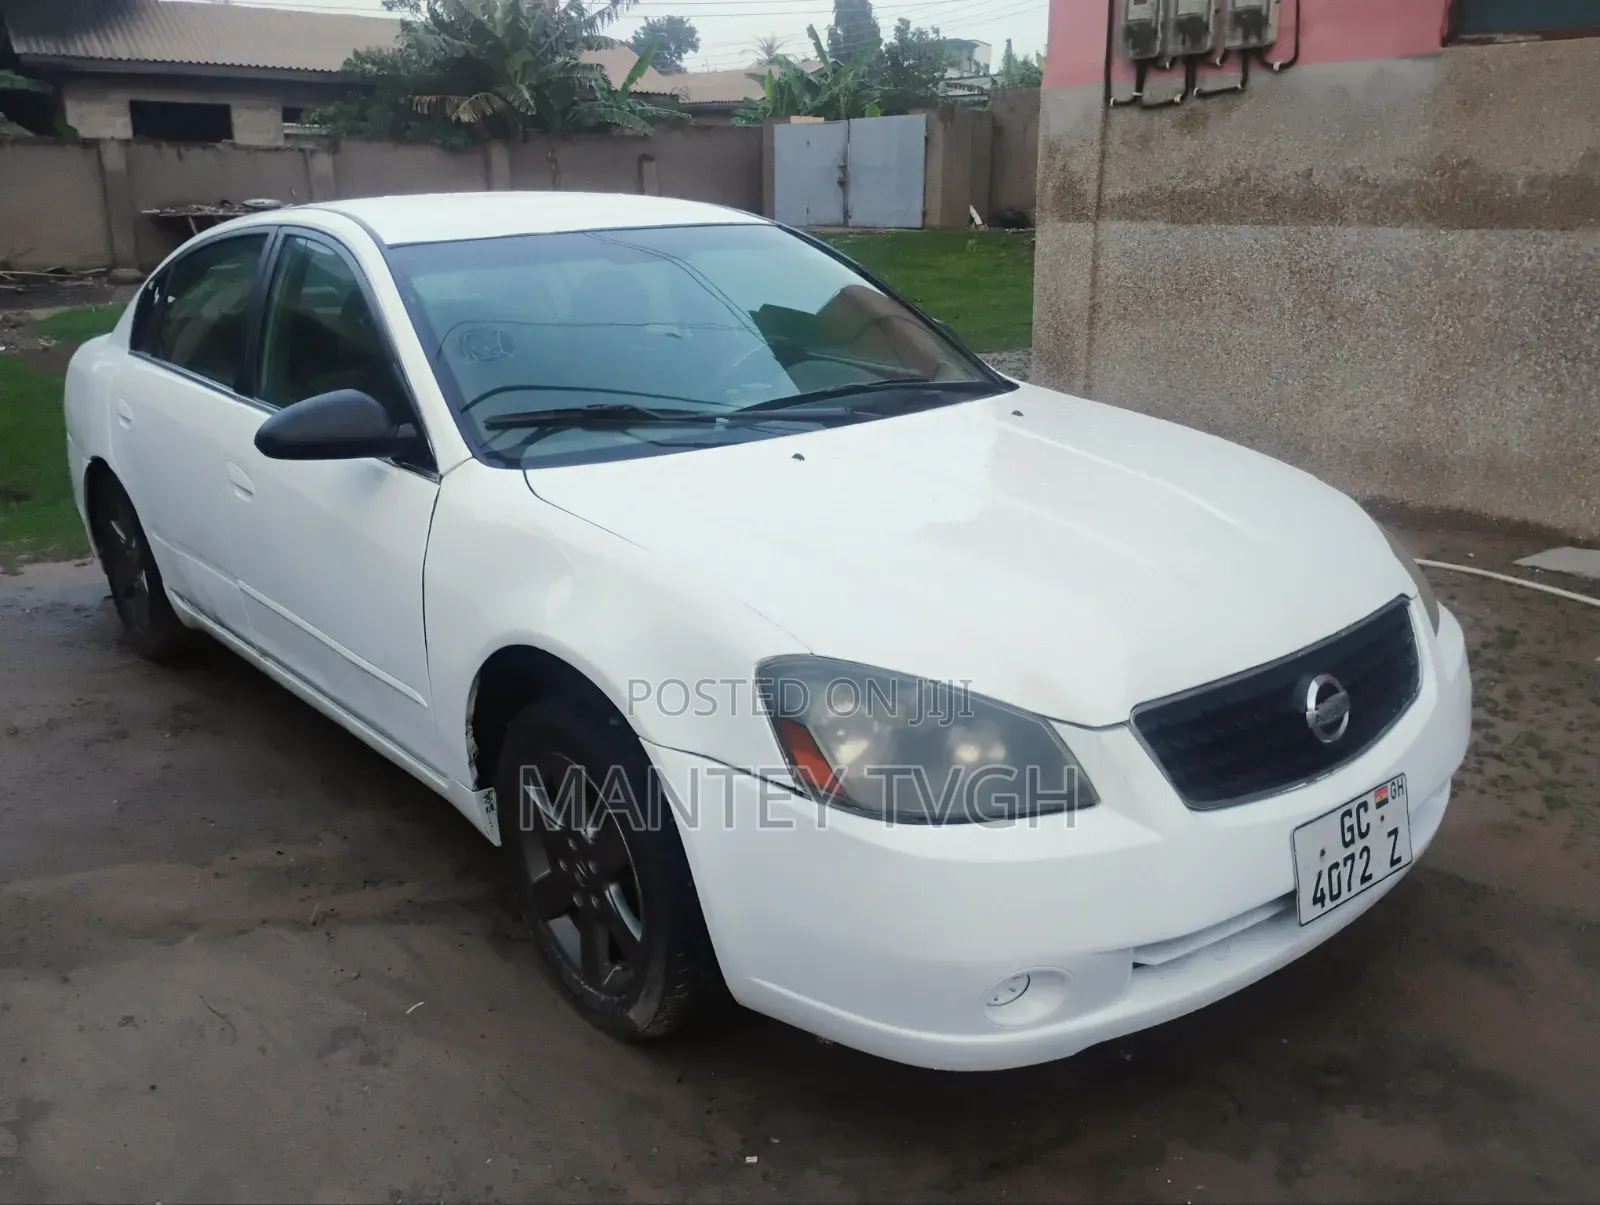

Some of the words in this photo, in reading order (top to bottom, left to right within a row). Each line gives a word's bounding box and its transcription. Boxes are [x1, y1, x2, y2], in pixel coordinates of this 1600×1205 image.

[1340, 800, 1370, 849] GC
[1390, 779, 1404, 800] GH
[1312, 845, 1373, 908] 4072
[1387, 827, 1401, 868] Z
